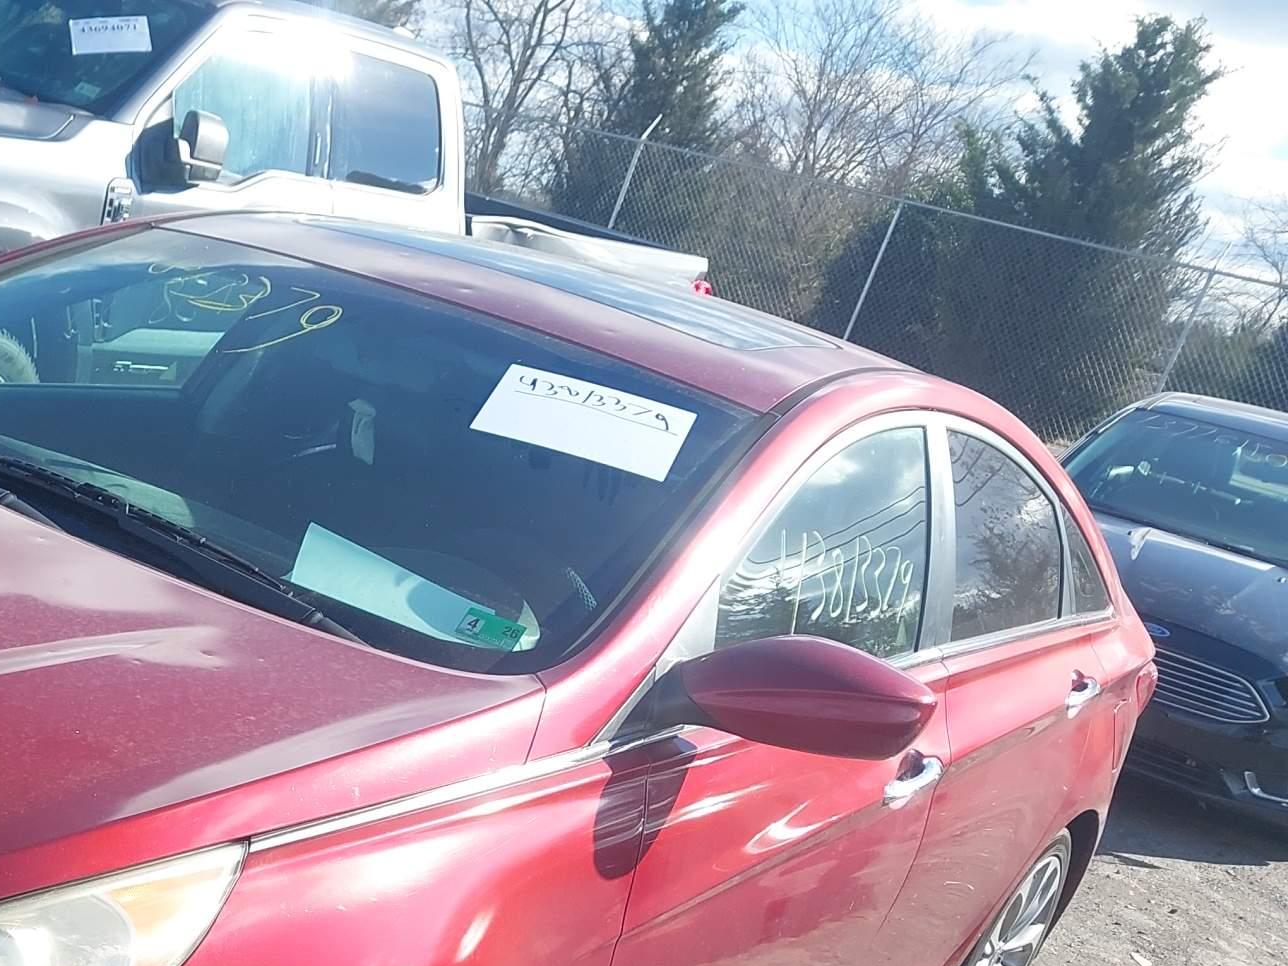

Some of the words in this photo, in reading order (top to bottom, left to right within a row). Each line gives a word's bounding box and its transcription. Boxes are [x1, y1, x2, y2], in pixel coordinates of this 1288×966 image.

[519, 373, 670, 431] 43813379
[780, 528, 913, 635] 43813379
[467, 617, 481, 630] 4
[501, 625, 521, 639] 26
